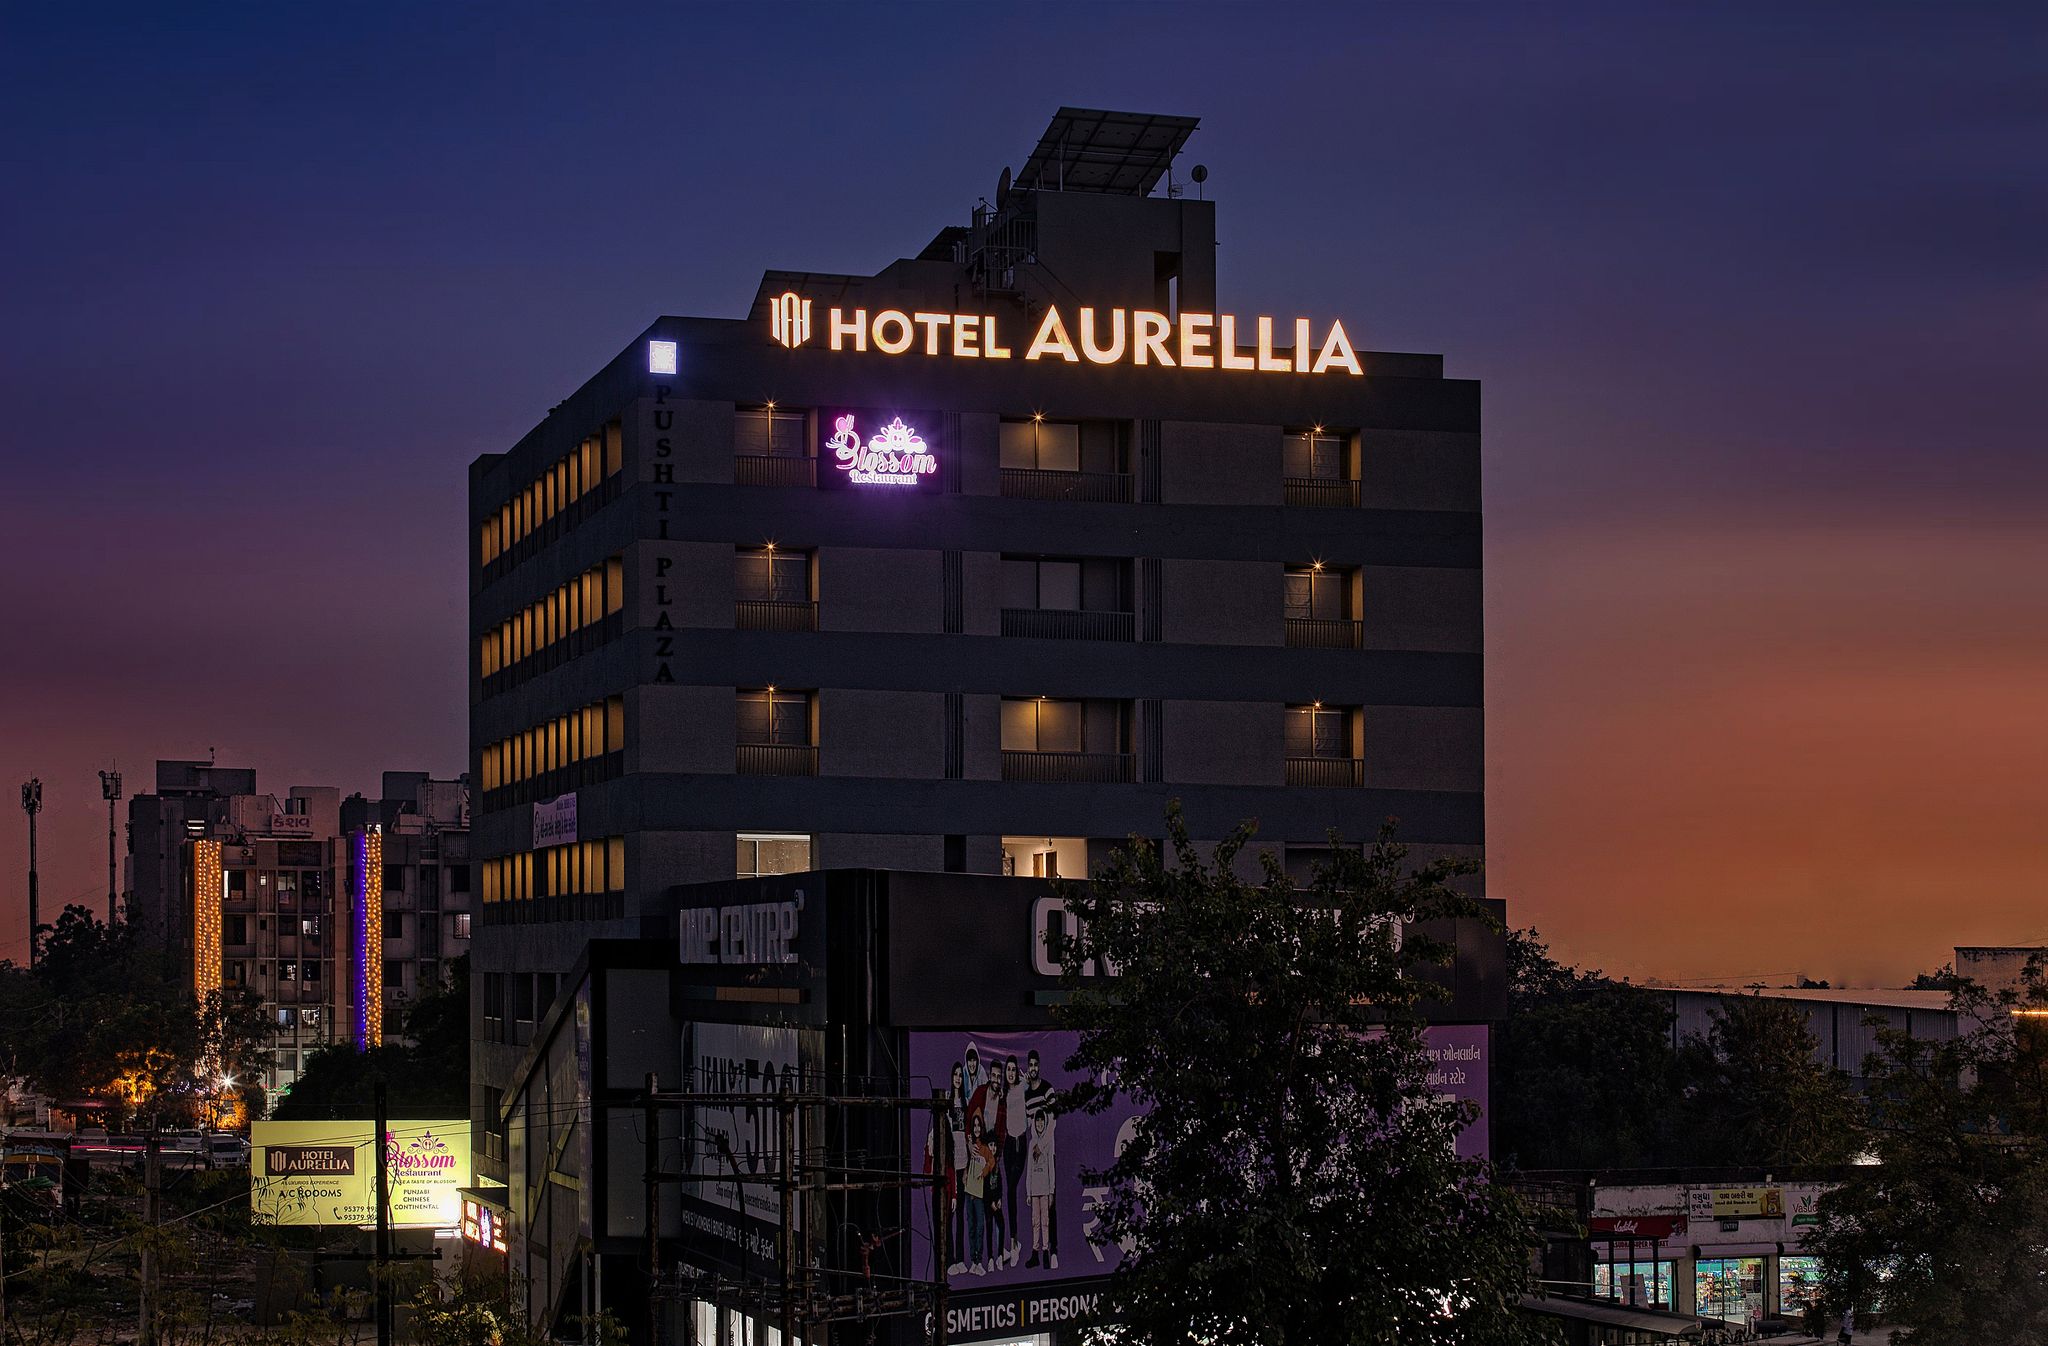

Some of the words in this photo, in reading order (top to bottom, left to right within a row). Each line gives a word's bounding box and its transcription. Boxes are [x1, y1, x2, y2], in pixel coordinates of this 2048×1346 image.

[830, 308, 1011, 359] HOTEL
[1025, 304, 1364, 376] AURELLIA
[654, 385, 674, 540] PUSHTI
[828, 420, 937, 473] Blossom
[849, 469, 918, 484] Restaurant
[655, 557, 675, 682] PLAZA
[288, 1160, 350, 1170] AURELLIA
[301, 1151, 337, 1160] HOTEL
[925, 1302, 1016, 1336] CSMETICS
[1029, 1293, 1103, 1324] PERSONA
